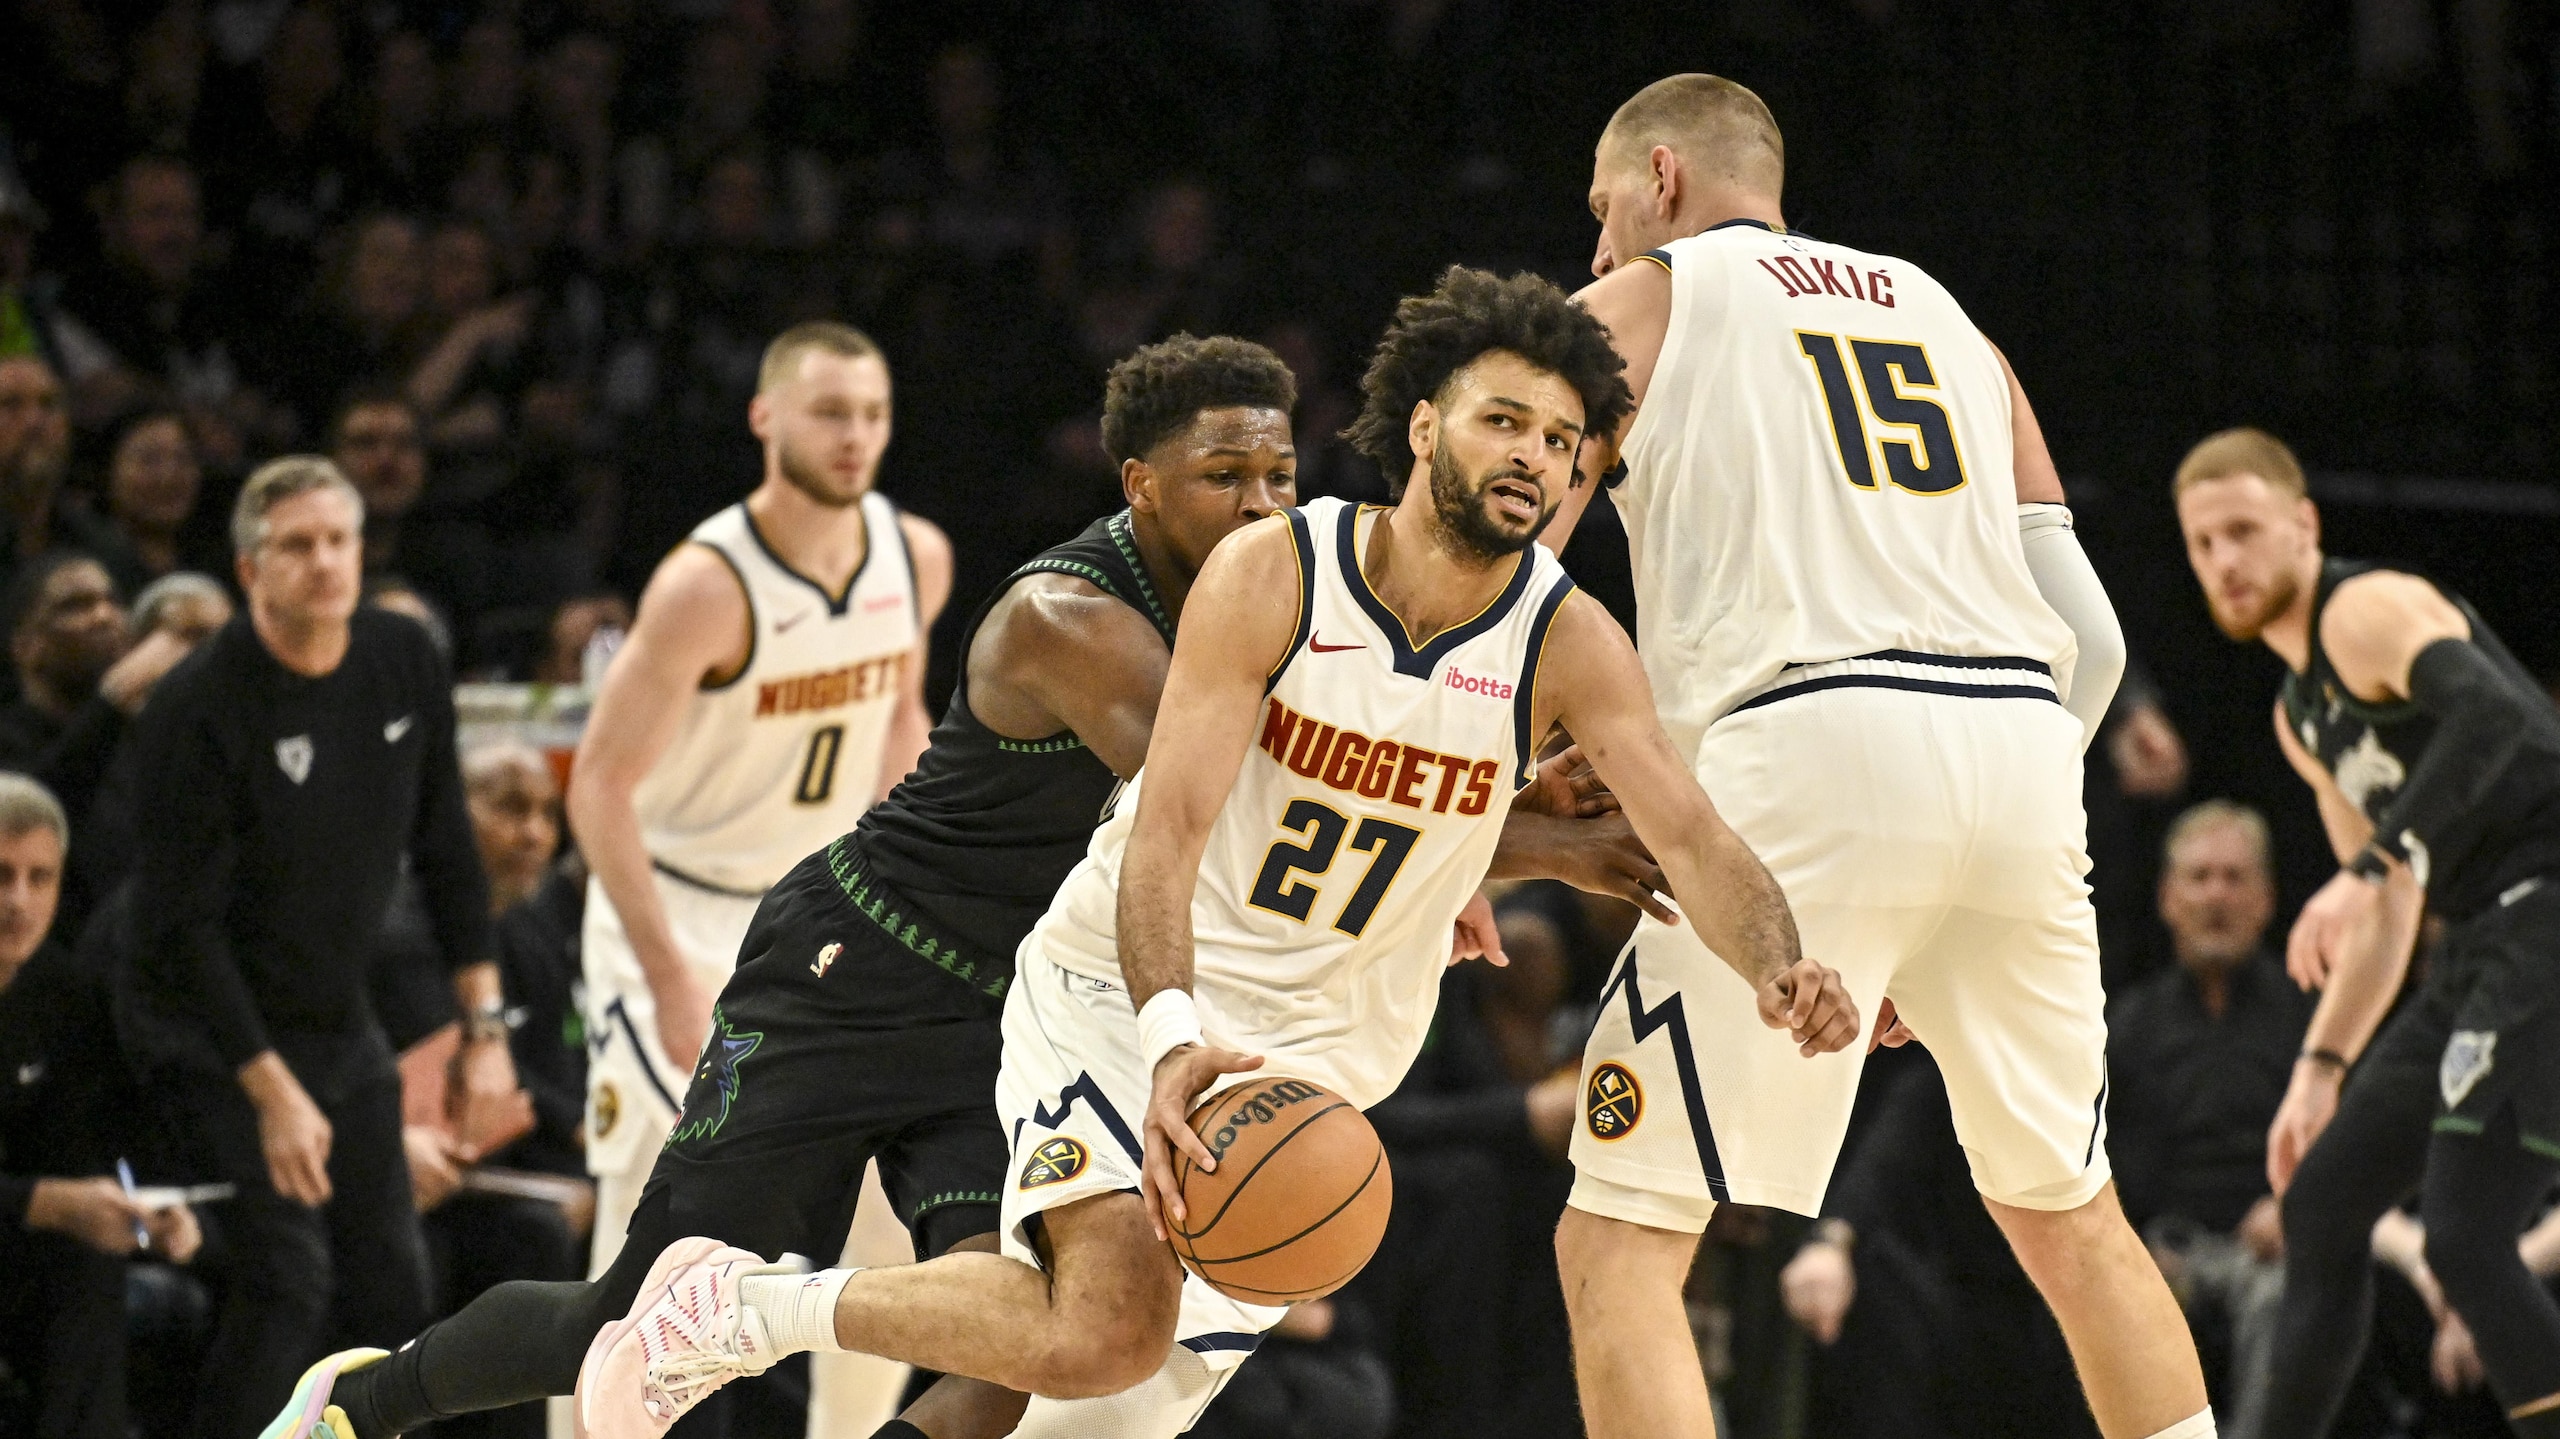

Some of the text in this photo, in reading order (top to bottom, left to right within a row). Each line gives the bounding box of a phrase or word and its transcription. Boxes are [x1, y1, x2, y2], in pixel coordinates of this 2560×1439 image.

[1756, 256, 1895, 308] JOKIĆ
[1793, 328, 1969, 497] 15
[1445, 666, 1513, 699] ibotta
[793, 722, 846, 805] 0
[1258, 696, 1501, 818] NUGGETS
[1245, 796, 1426, 941] 27
